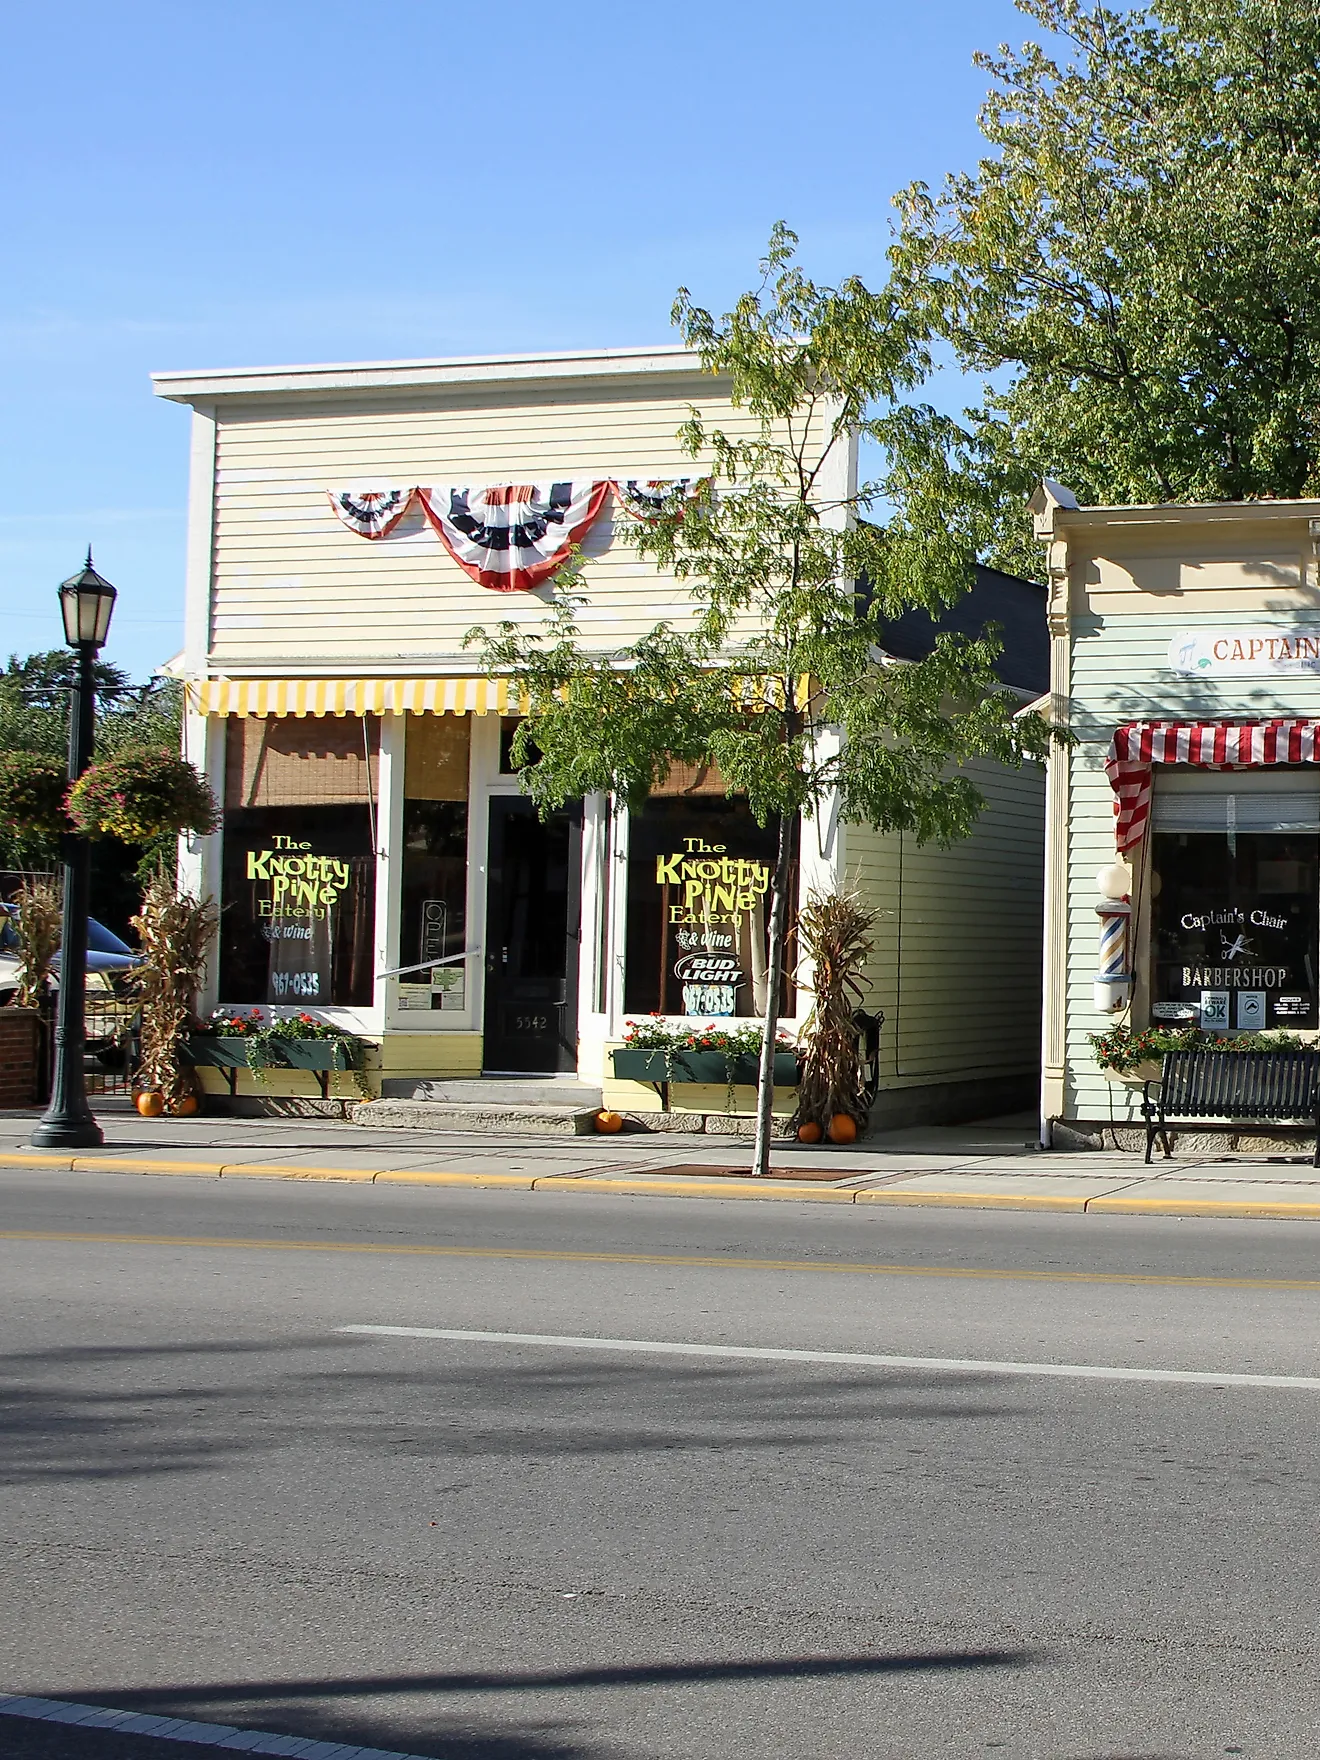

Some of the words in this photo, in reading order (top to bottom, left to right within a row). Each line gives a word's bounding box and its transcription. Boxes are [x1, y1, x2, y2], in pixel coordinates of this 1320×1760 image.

[272, 835, 312, 850] The
[682, 838, 727, 853] The
[258, 899, 325, 921] Eatery
[668, 905, 743, 927] Eatery
[1181, 908, 1245, 931] Captain's
[1250, 910, 1288, 930] Chair
[283, 924, 313, 940] wine
[689, 933, 699, 945] &
[701, 930, 732, 948] wine
[691, 958, 736, 970] BUD
[682, 970, 744, 982] LIGHT
[1182, 966, 1287, 988] BARBERSHOP
[516, 1016, 547, 1029] 5542
